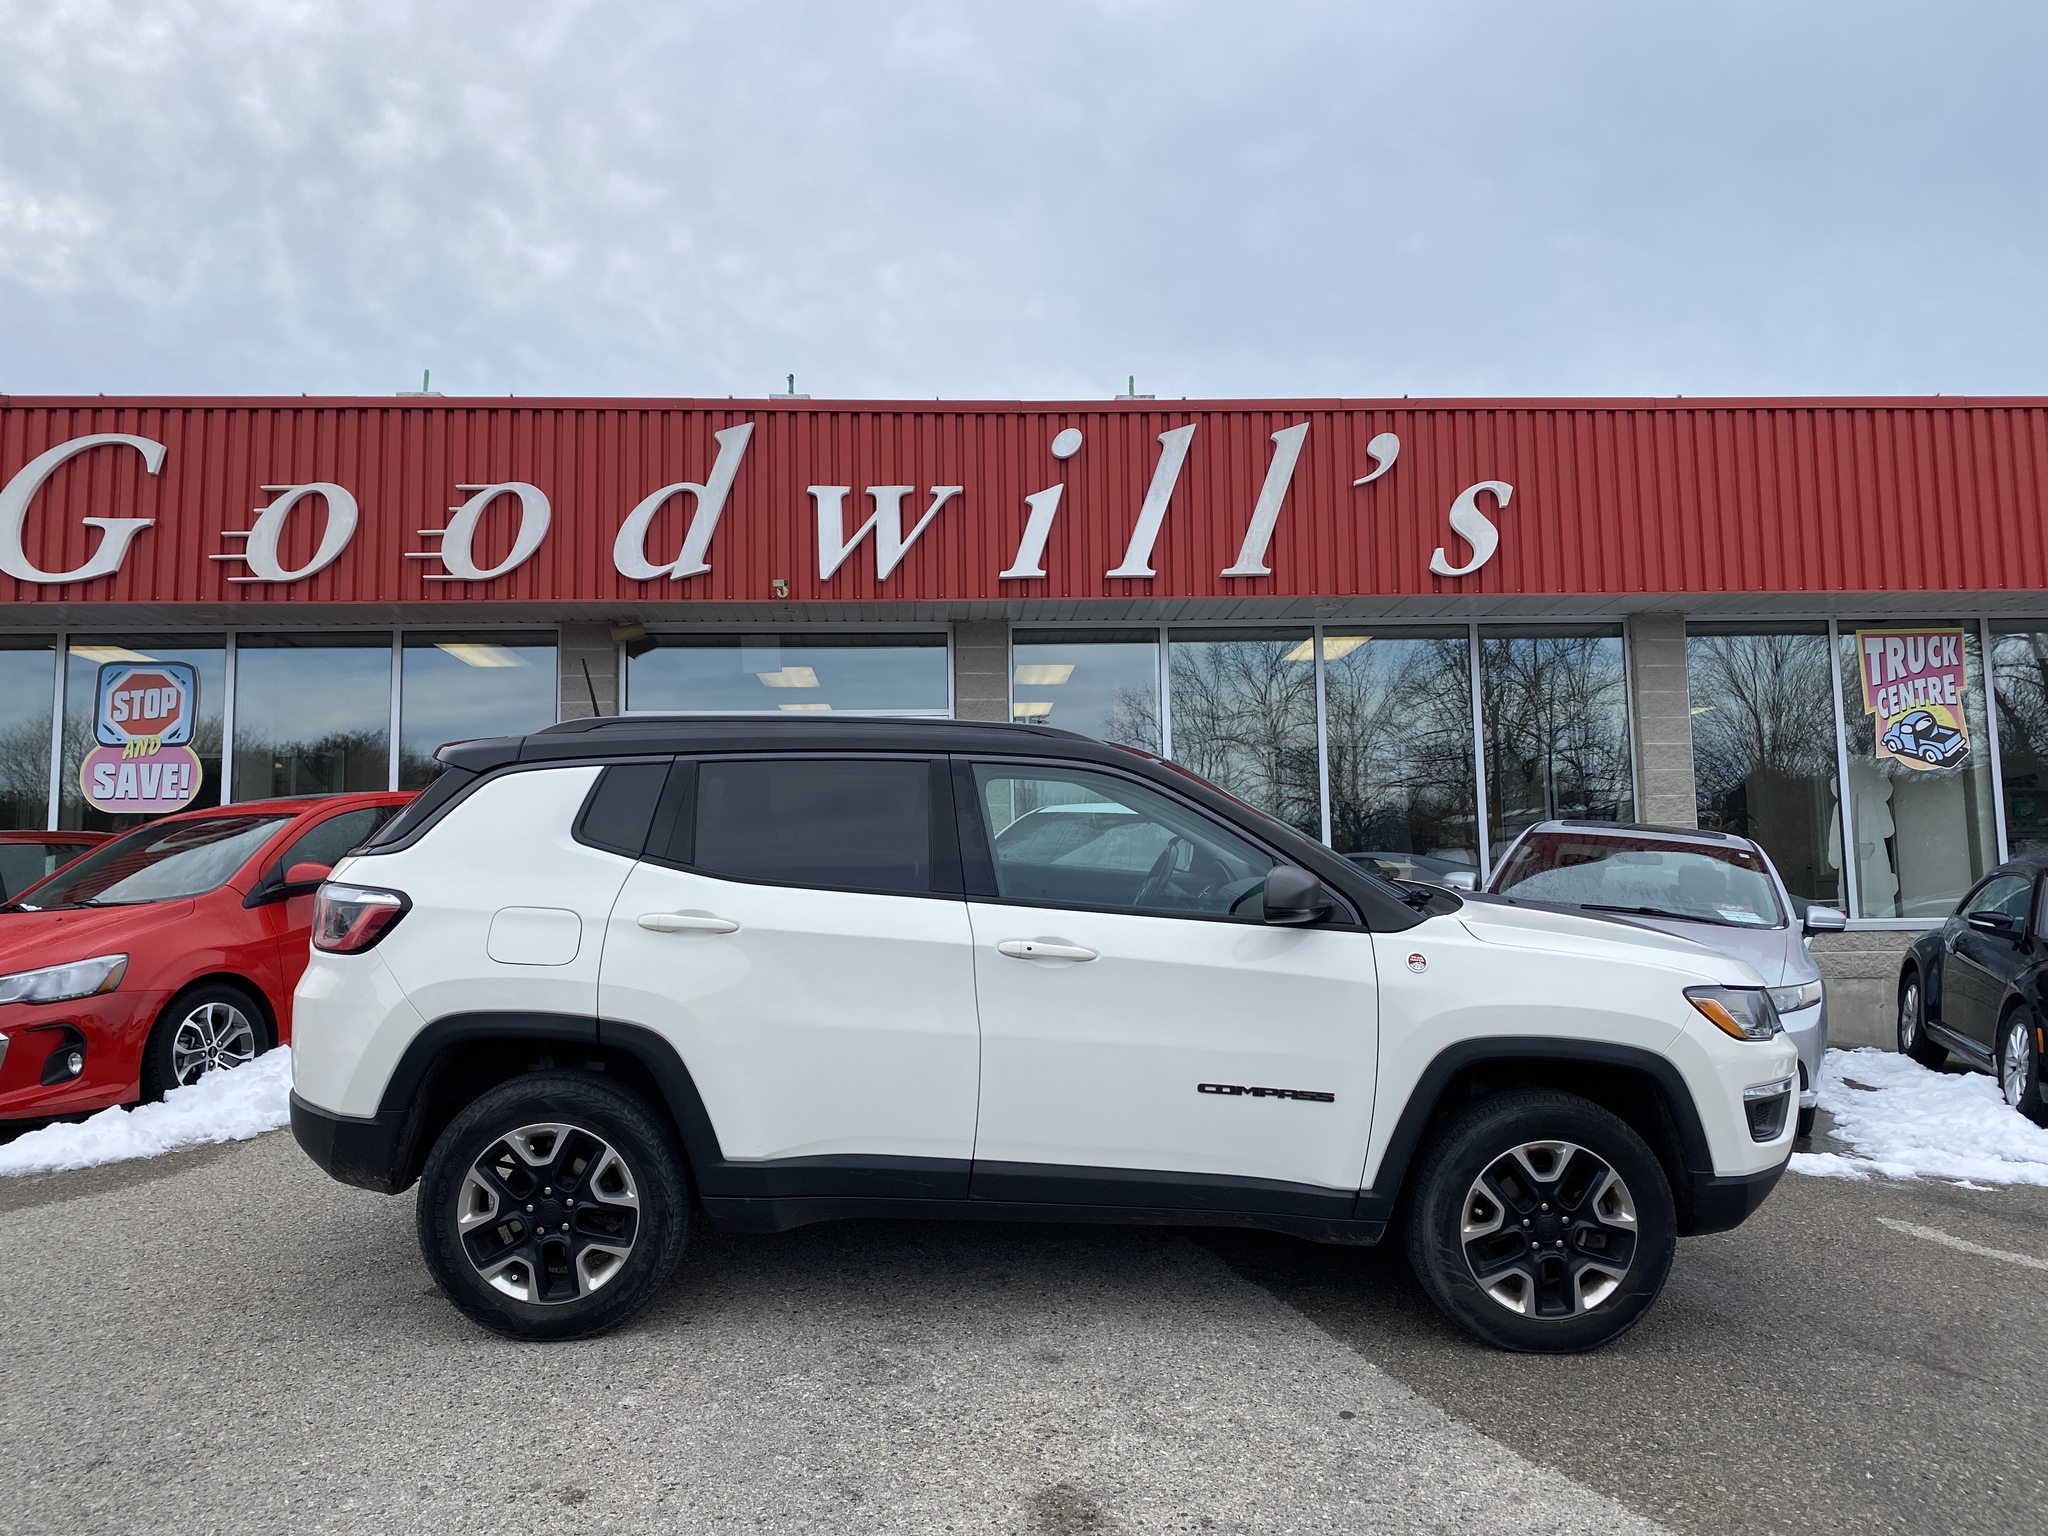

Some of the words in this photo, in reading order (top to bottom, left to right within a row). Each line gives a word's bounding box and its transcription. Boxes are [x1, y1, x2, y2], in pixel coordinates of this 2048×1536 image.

[0, 422, 1514, 585] Goodwill's
[1865, 635, 1960, 687] TRUCK
[112, 687, 178, 722] STOP
[1877, 674, 1958, 720] CENTRE
[122, 735, 162, 760] AND
[92, 763, 191, 800] SAVE!
[1197, 1083, 1335, 1103] COMPASS
